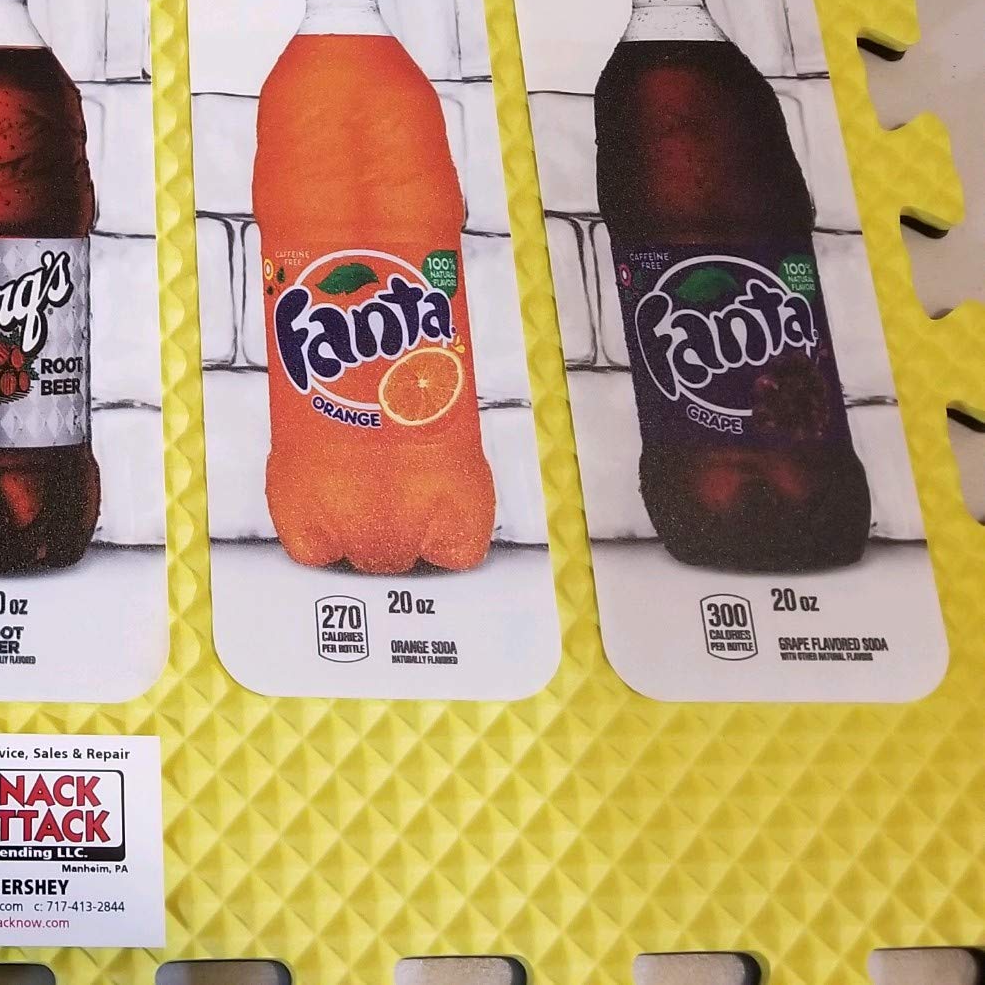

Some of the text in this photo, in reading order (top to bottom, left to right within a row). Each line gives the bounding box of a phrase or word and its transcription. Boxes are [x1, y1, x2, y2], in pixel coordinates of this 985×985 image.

[276, 251, 310, 259] CAFFEINE
[629, 252, 669, 261] CAFFEINE
[641, 262, 662, 270] FREE
[274, 273, 452, 395] Fanta
[635, 278, 816, 401] Fanta
[41, 357, 82, 375] ROOT
[41, 379, 81, 395] BEER
[312, 396, 382, 428] ORANGE
[686, 404, 743, 434] GRAPE
[387, 591, 435, 614] 20 oz
[771, 588, 819, 611] 20 oz
[10, 599, 28, 615] oz
[322, 605, 361, 629] 270
[707, 603, 747, 627] 300
[322, 632, 363, 642] CALORIES
[710, 630, 751, 640] CALORIES
[339, 644, 365, 653] BOTTLE
[391, 640, 457, 654] ORANGE SODA
[710, 642, 754, 651] PER BOTTLE
[778, 638, 889, 651] GRAPE FLAVORED SODA
[33, 748, 68, 759] Sales
[73, 749, 82, 759] &
[87, 749, 131, 762] Repair
[57, 848, 87, 858] LLC.
[62, 865, 128, 874] Manheim, PA
[34, 903, 43, 911] c:
[46, 901, 125, 912] 717-413-2844
